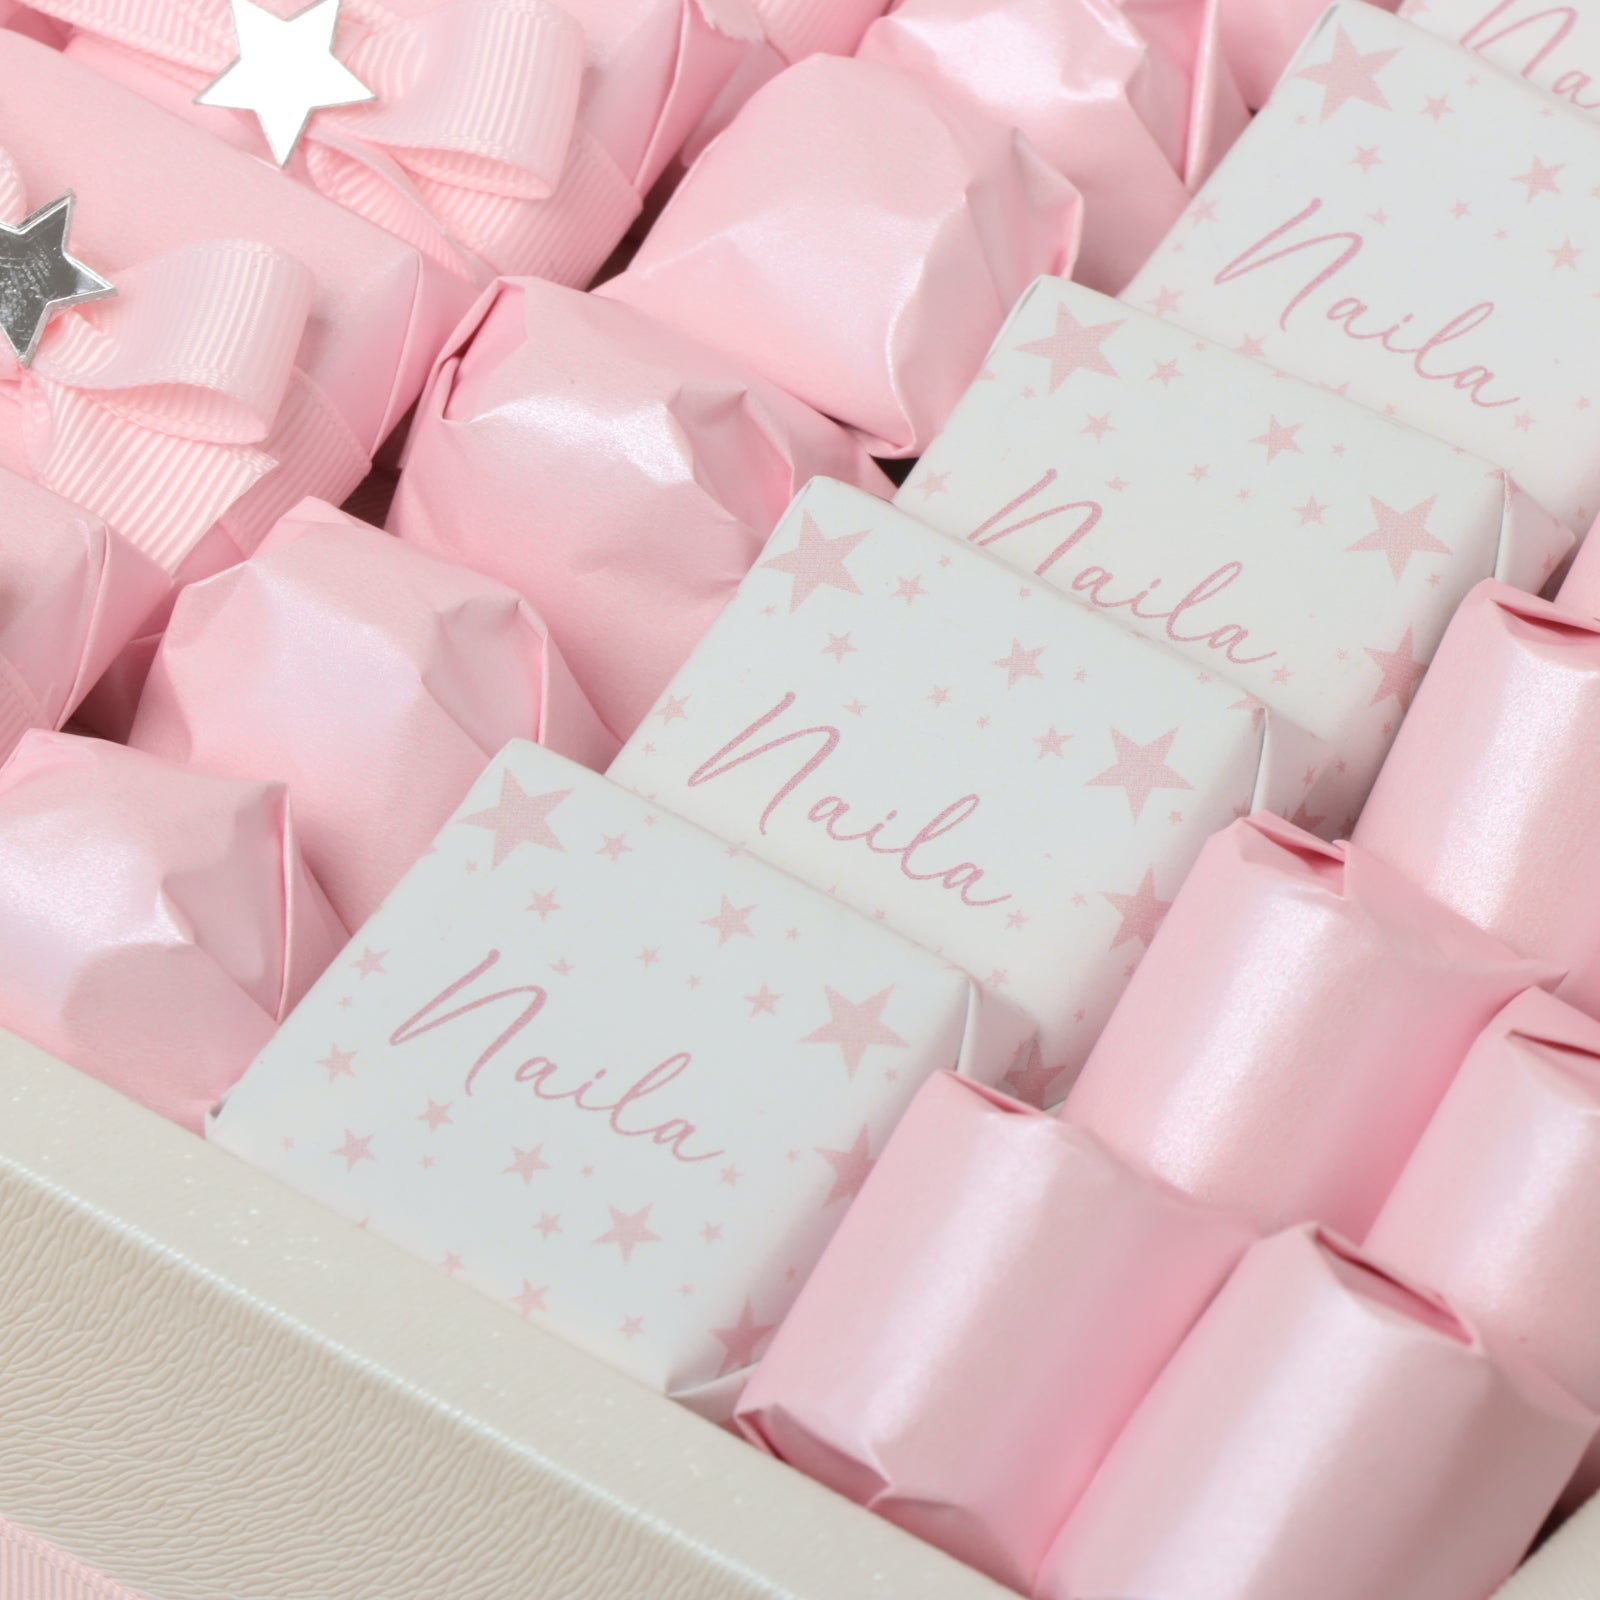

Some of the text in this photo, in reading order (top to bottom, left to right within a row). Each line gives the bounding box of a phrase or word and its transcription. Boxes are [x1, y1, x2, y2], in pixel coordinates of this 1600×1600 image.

[1213, 197, 1521, 408] Naila
[966, 468, 1278, 665] Naila
[687, 691, 1013, 907] Naila
[388, 948, 726, 1163] Naila
